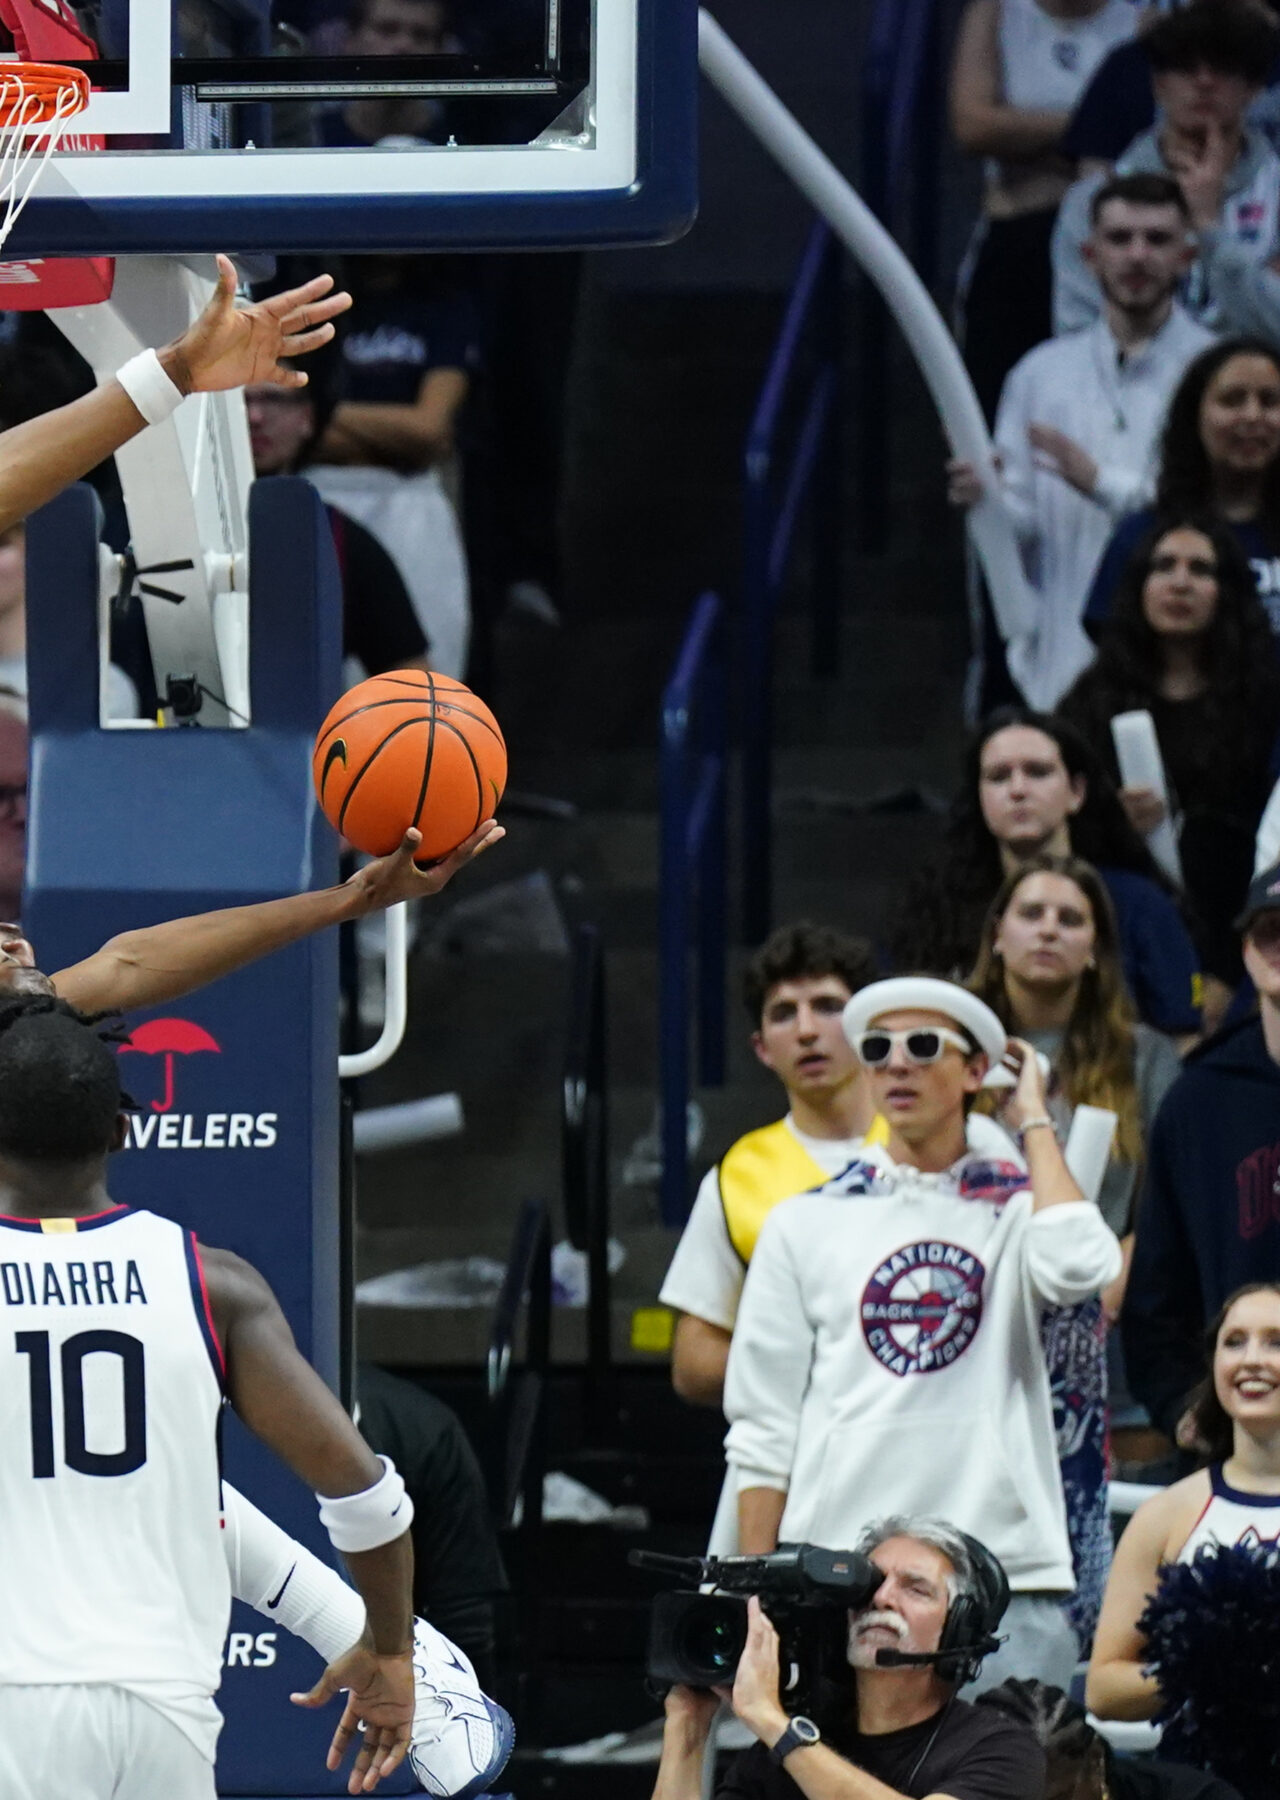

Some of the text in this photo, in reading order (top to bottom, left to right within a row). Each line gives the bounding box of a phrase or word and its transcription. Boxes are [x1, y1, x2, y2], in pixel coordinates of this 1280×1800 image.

[0, 1259, 148, 1306] DIARRA
[874, 1242, 977, 1288] NATIONA
[14, 1329, 147, 1479] 10
